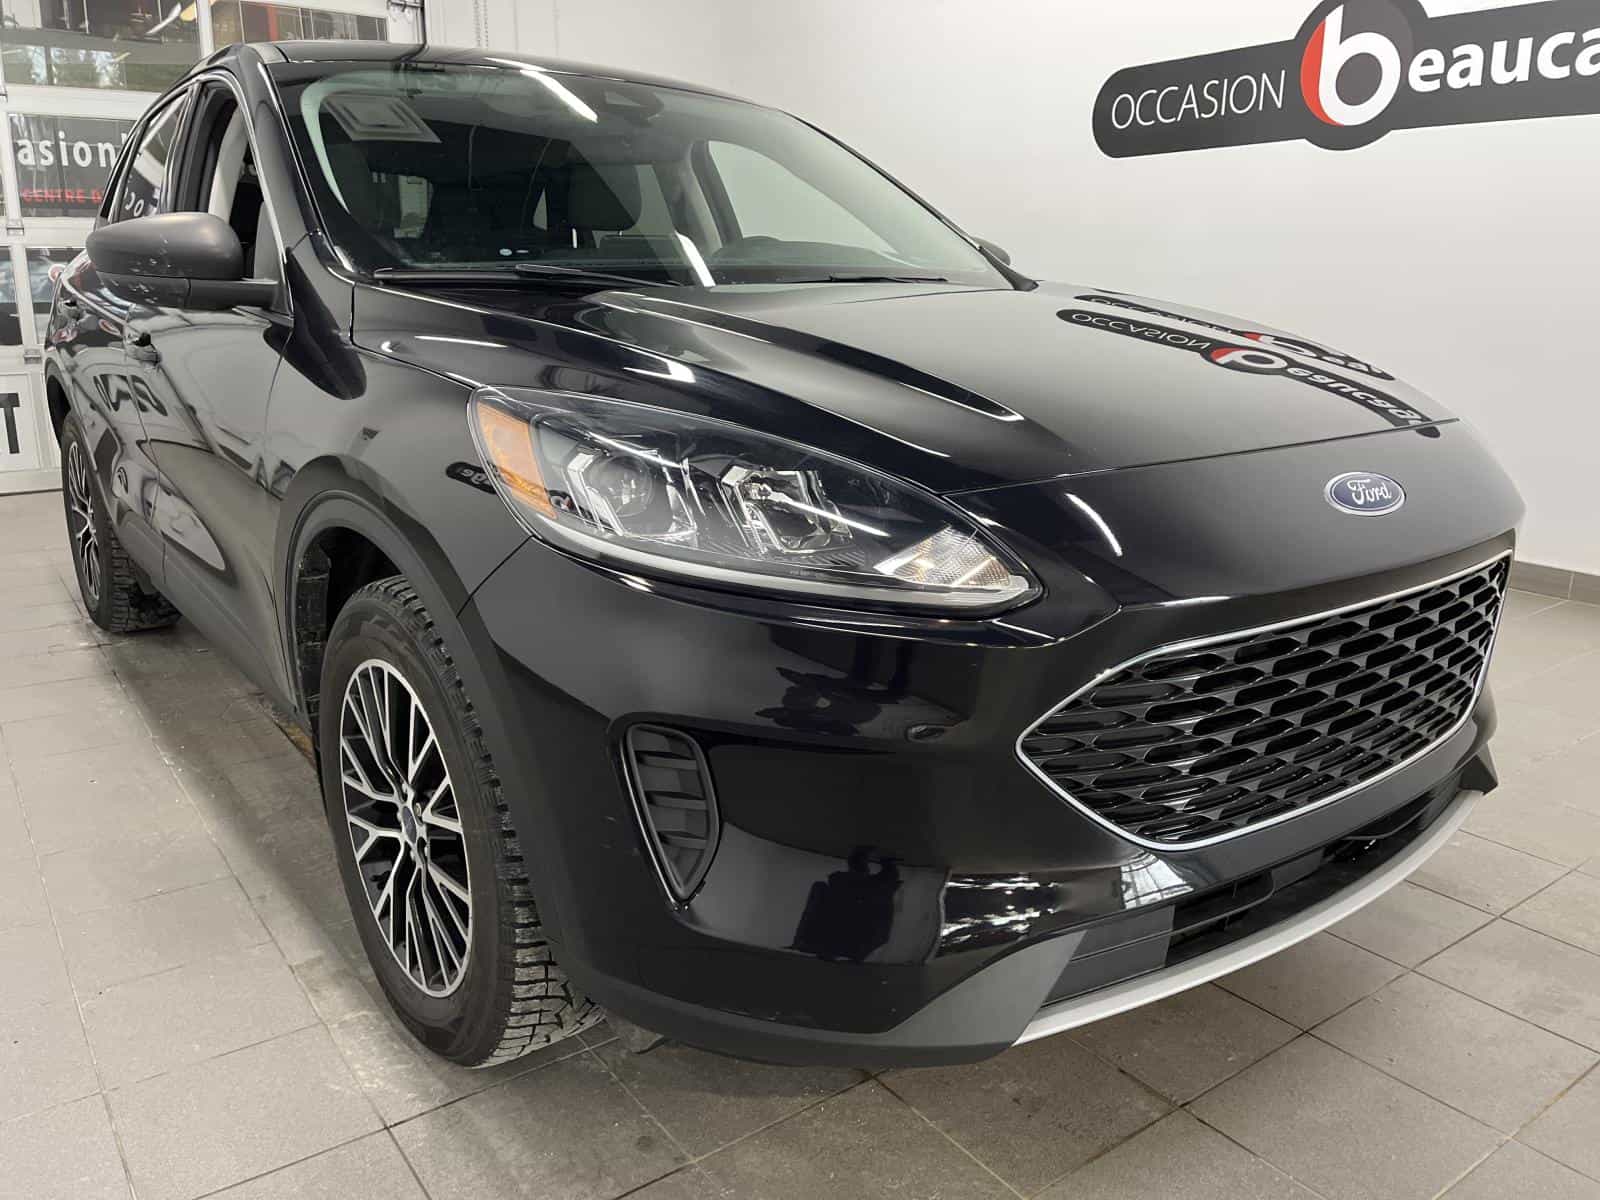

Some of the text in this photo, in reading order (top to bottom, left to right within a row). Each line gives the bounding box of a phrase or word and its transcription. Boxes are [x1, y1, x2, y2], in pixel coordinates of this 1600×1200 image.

[1111, 69, 1286, 130] OCCASION
[16, 131, 129, 168] asion
[1347, 479, 1392, 505] Ford
